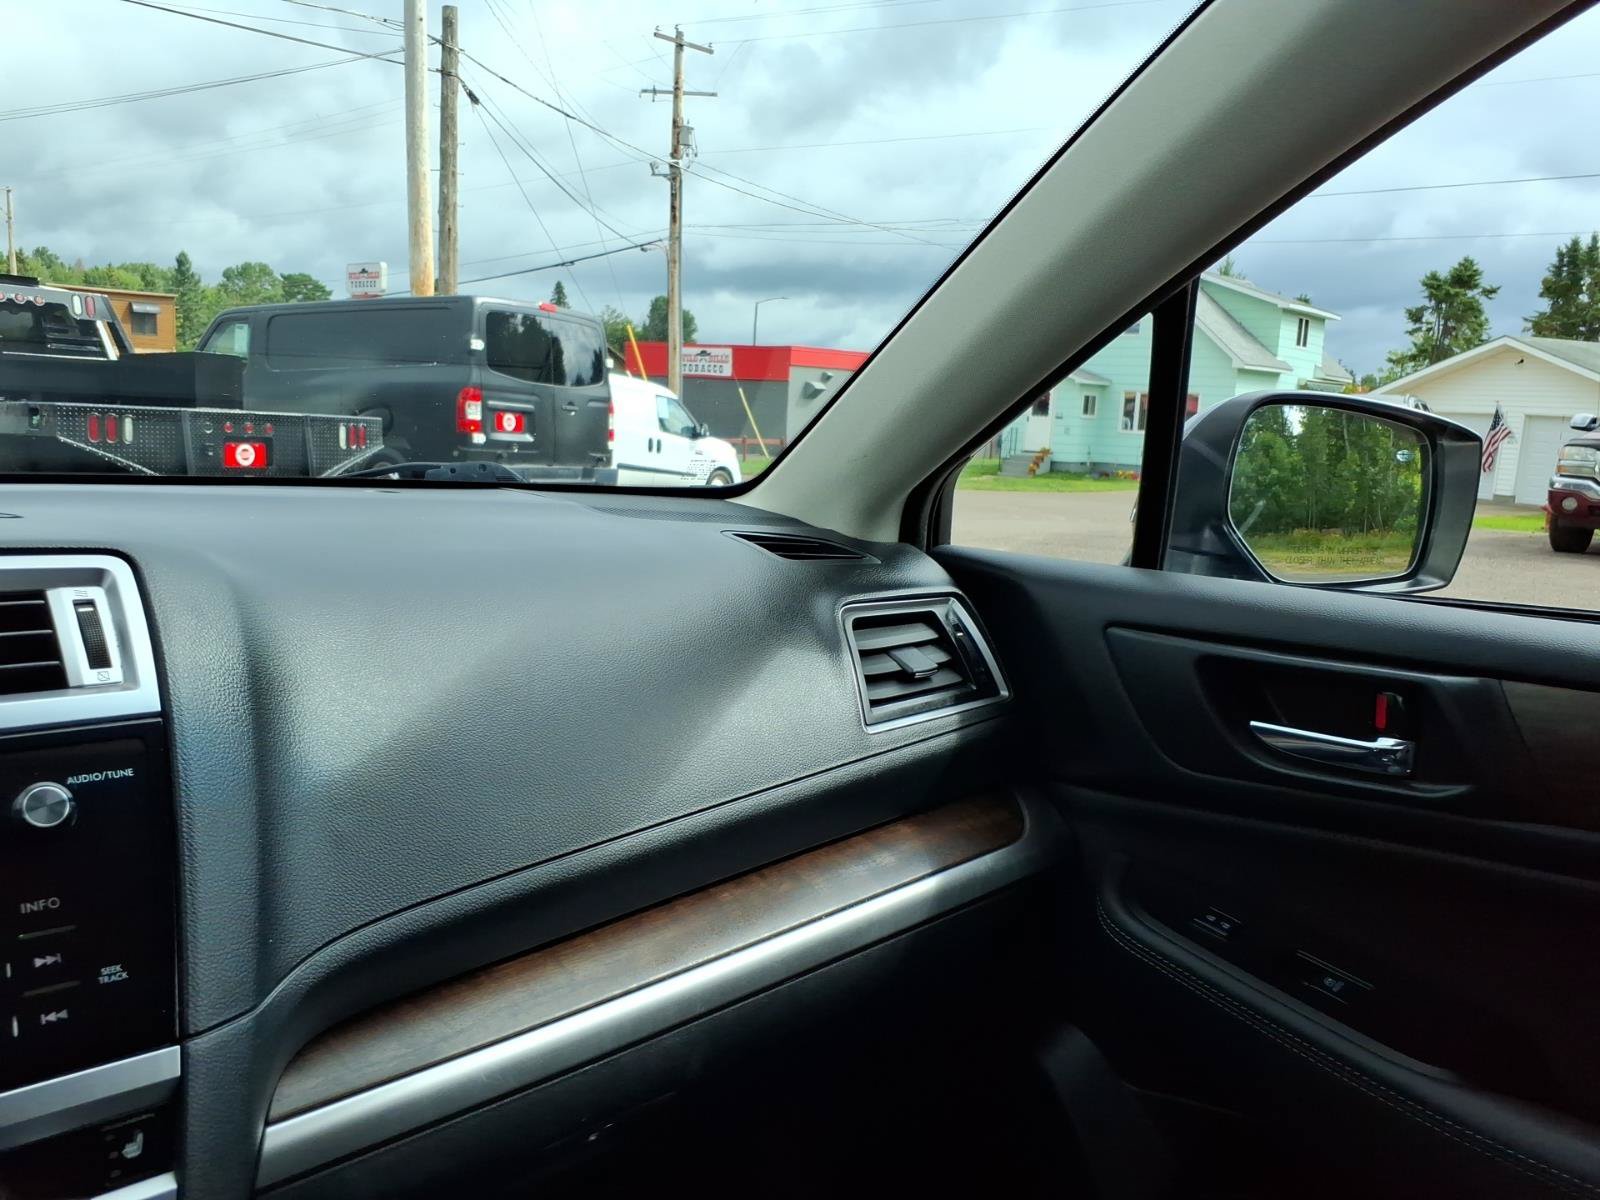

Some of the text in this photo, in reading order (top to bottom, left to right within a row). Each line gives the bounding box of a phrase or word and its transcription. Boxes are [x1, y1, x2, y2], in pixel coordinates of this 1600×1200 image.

[683, 363, 723, 374] TOBACCO
[66, 768, 135, 785] AUDIO/TUNE
[20, 897, 61, 914] INFO
[100, 964, 122, 975] SEEK
[98, 971, 129, 985] TRACK
